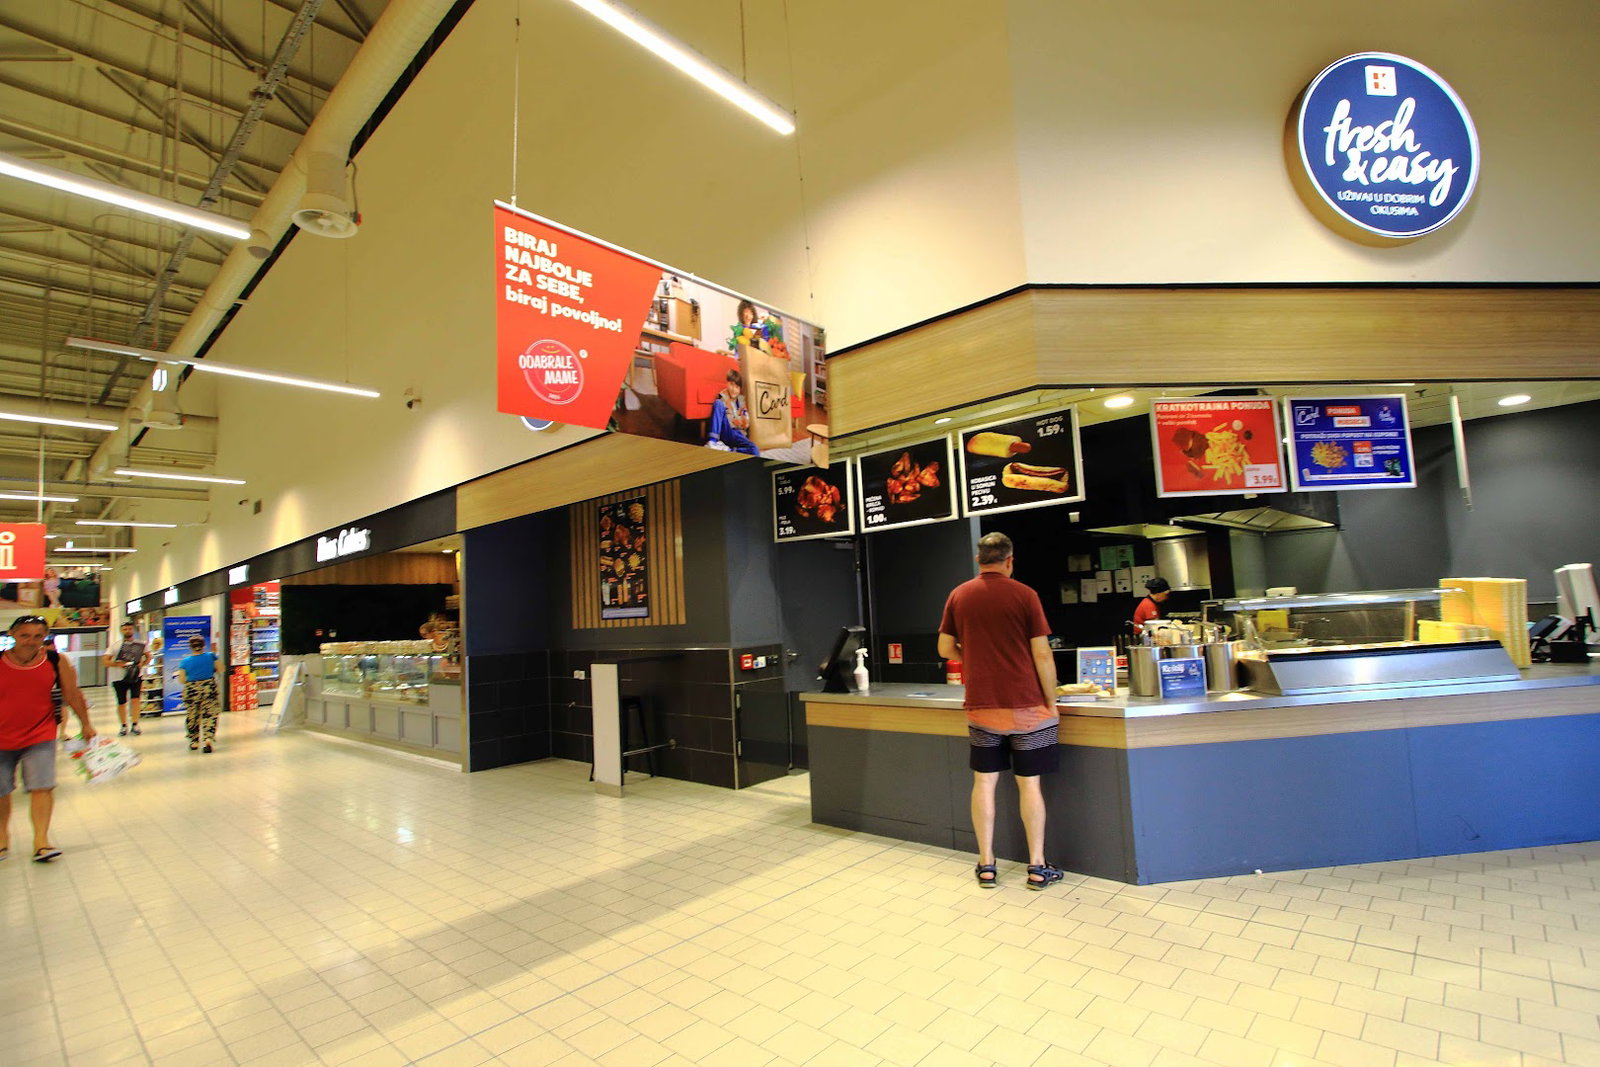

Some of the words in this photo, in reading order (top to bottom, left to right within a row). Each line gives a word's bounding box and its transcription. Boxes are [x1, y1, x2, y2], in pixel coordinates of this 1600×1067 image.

[1323, 97, 1421, 166] fresh
[1374, 193, 1383, 203] U
[1384, 193, 1425, 204] DOBRIM
[504, 226, 558, 258] BIRAJ
[505, 244, 593, 287] NAJBOLJE
[505, 264, 533, 286] ZA
[536, 274, 585, 304] SEBE,
[505, 284, 548, 314] biraj
[551, 302, 623, 333] povoljno!
[518, 354, 574, 369] ODABRALE
[544, 370, 580, 385] MAME
[760, 387, 788, 415] Card
[1156, 402, 1230, 412] KRATKOTRAJNA
[1230, 401, 1271, 410] PONUDA
